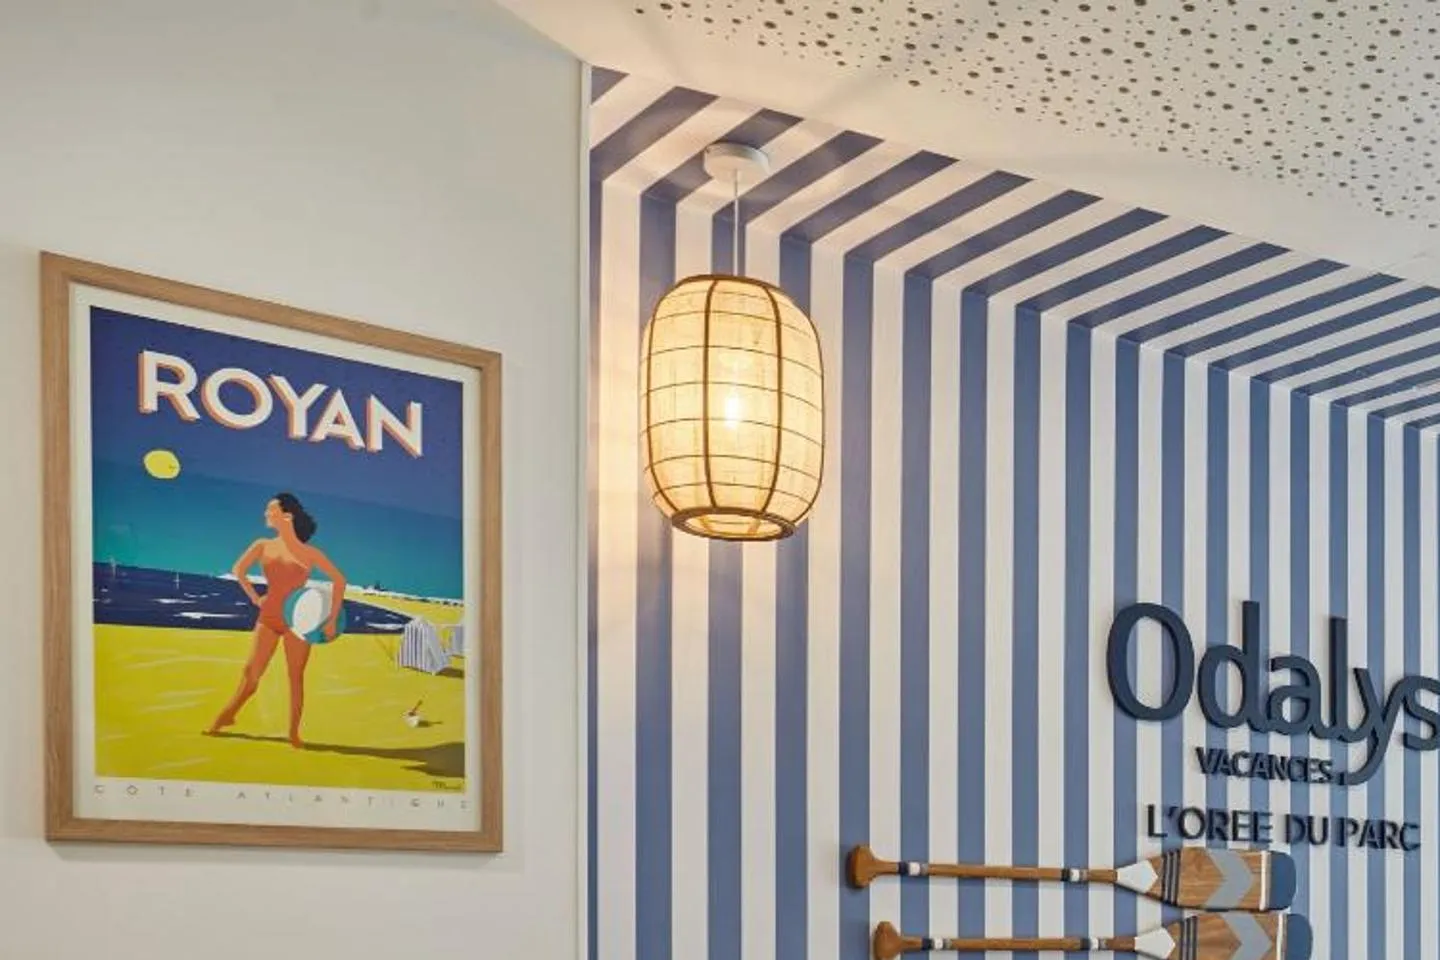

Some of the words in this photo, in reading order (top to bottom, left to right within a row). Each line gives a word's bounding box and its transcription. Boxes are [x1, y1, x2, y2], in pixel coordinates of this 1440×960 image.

[138, 350, 423, 458] ROYAN
[1195, 746, 1333, 784] VACANCES
[1284, 812, 1329, 846] DU
[1338, 816, 1421, 851] PARC
